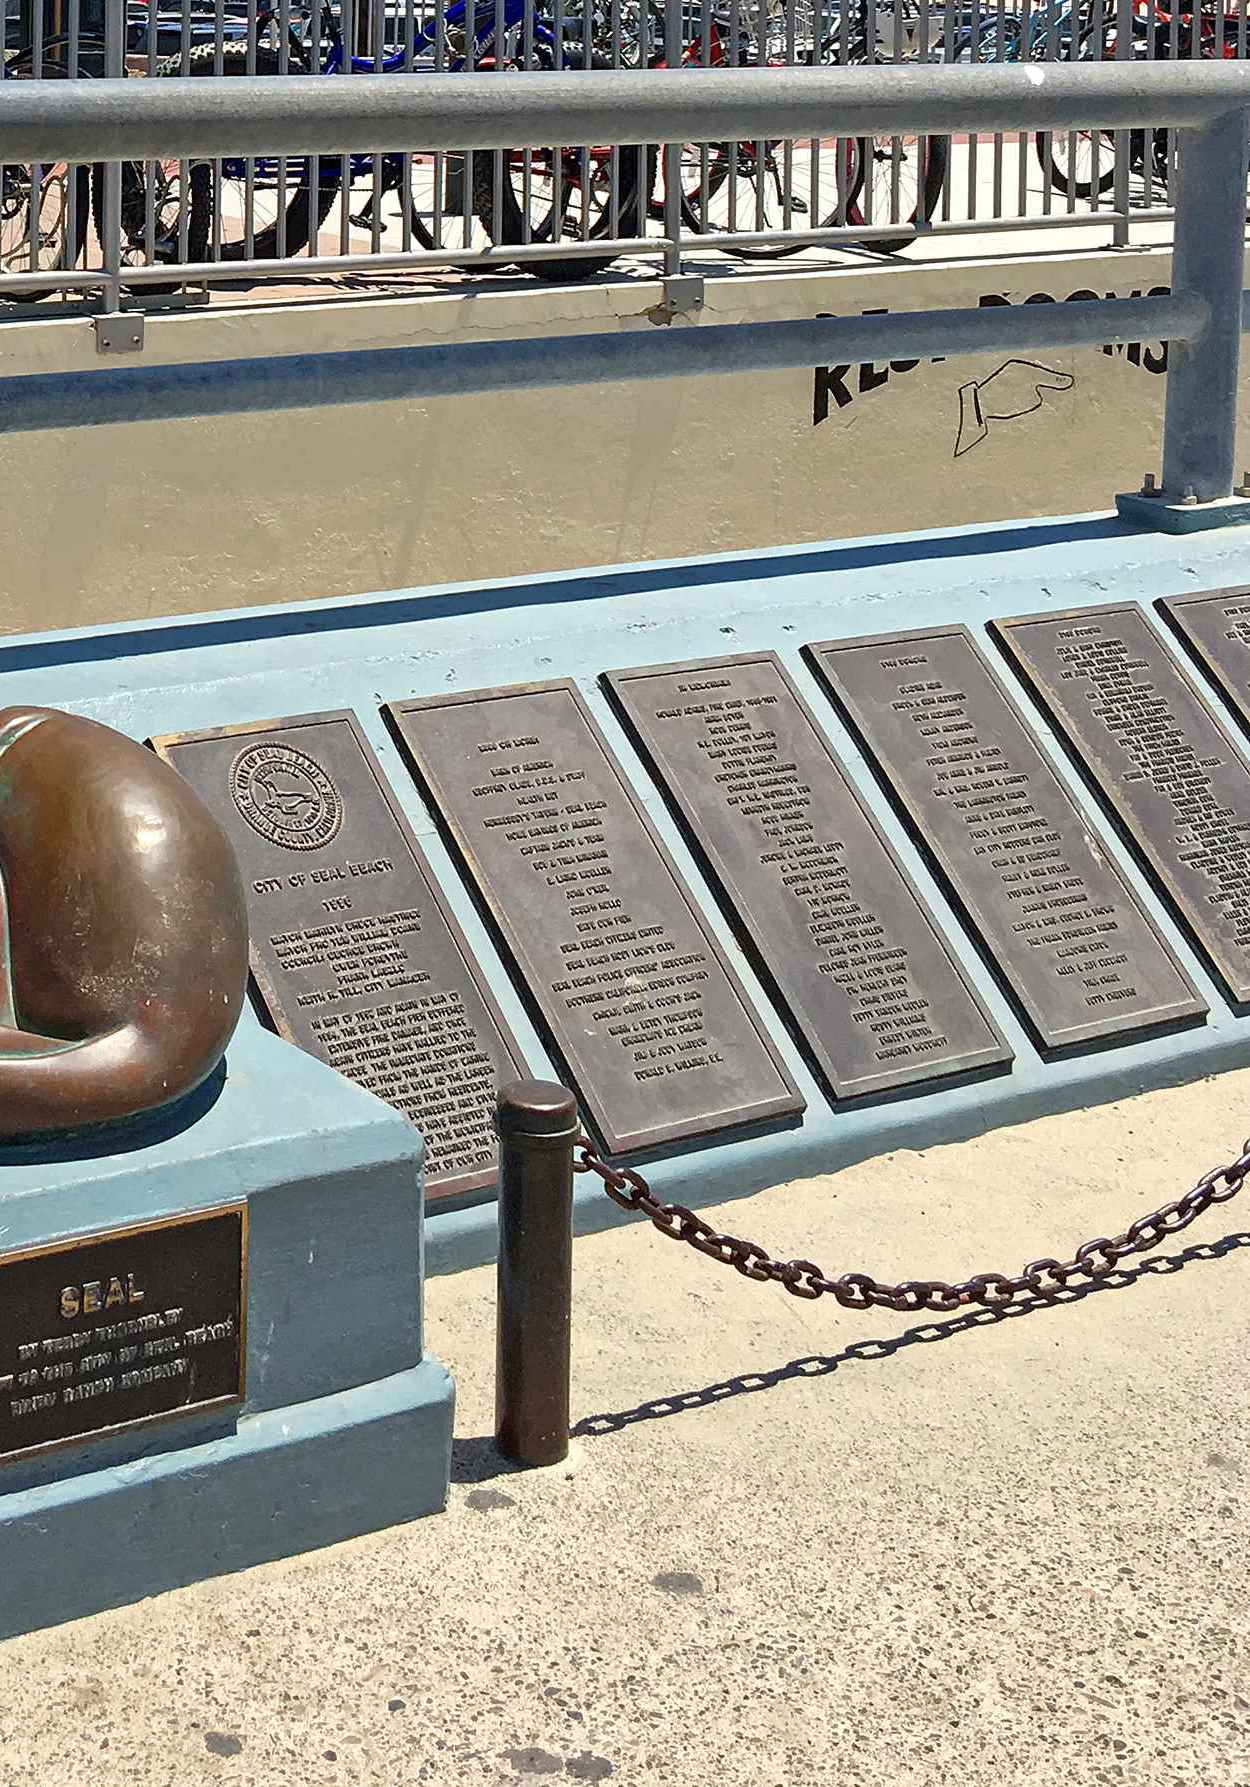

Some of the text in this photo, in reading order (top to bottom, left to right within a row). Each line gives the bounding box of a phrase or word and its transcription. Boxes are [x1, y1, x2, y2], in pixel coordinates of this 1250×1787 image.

[252, 860, 394, 894] CITY OF SEAL BEACH
[60, 1272, 145, 1319] SEAL
[17, 1341, 38, 1360] BY
[18, 1368, 37, 1387] TO
[41, 1361, 73, 1381] THE
[79, 1351, 112, 1372] CITY
[119, 1345, 138, 1363] OF
[144, 1335, 180, 1357] SEAL
[183, 1316, 234, 1346] BEACH
[121, 1357, 189, 1387] COMPANY
